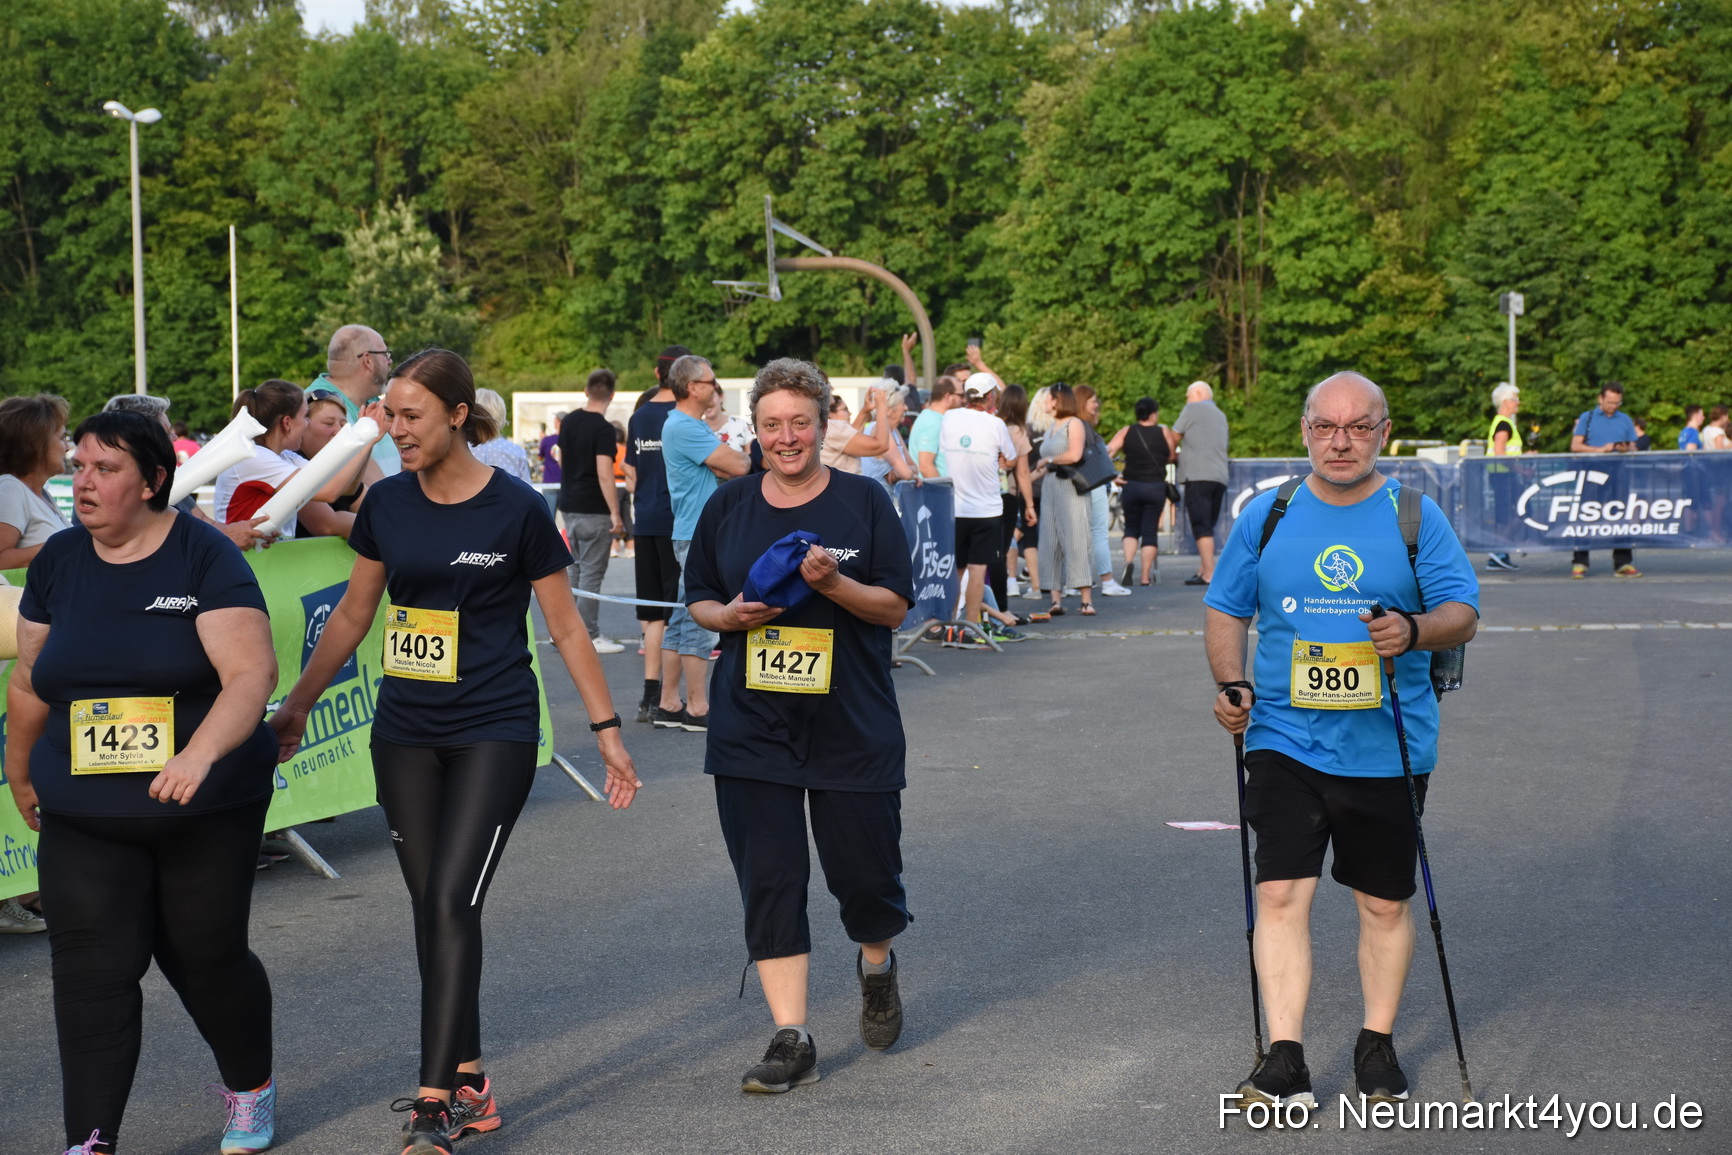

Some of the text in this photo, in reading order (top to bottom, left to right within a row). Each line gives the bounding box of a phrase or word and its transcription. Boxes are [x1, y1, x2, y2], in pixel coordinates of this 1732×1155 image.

[1548, 493, 1692, 522] Fischer
[1562, 523, 1680, 537] AUTOMOBILE
[450, 552, 491, 566] JURA
[145, 596, 187, 610] JURA
[1304, 597, 1378, 605] Handwerkskammer
[390, 631, 444, 661] 1403
[757, 648, 820, 674] 1427
[1308, 666, 1359, 691] 980
[1298, 690, 1320, 698] Burger
[84, 724, 159, 752] 1423
[120, 752, 144, 761] Sylvia
[293, 737, 354, 780] neumarkt
